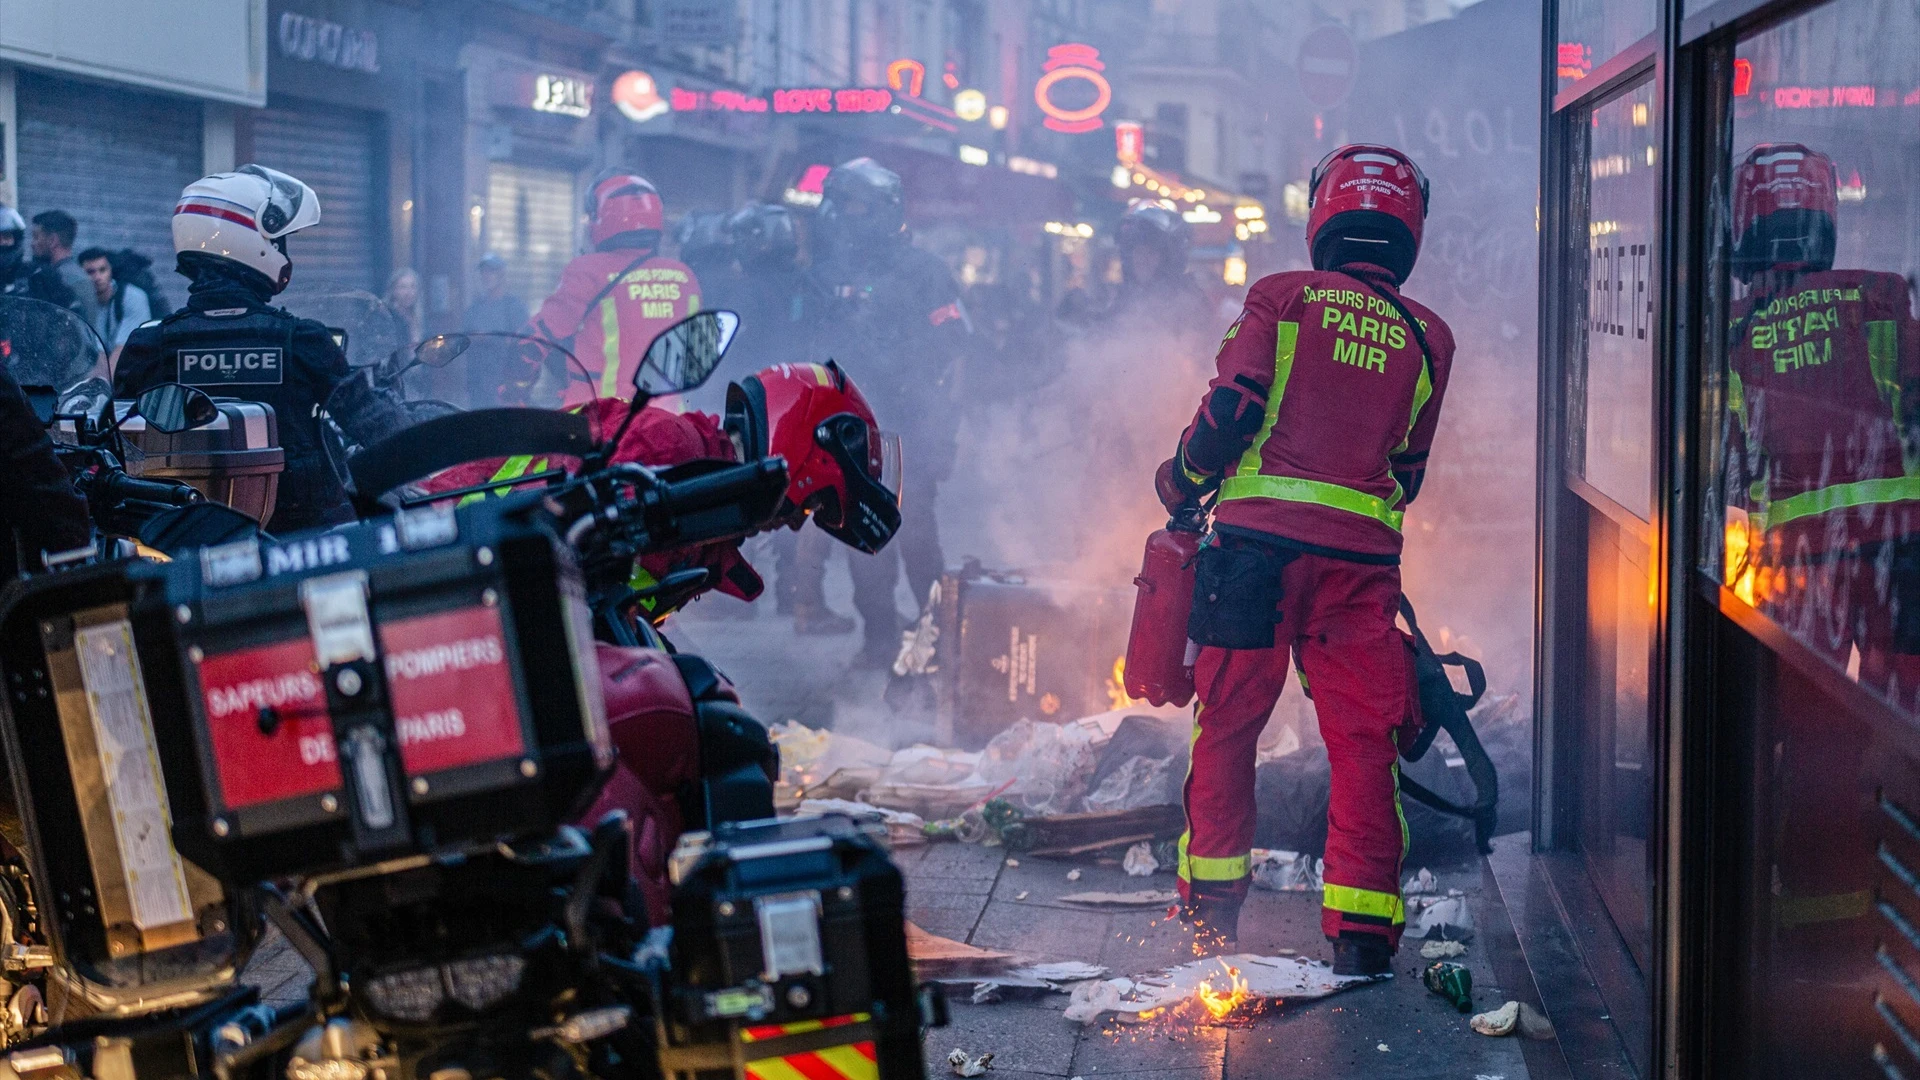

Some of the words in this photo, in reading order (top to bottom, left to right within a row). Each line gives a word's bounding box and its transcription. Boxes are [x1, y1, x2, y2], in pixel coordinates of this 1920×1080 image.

[774, 88, 832, 113] LOVE
[1340, 177, 1405, 197] SAPEURS-POMPIERS
[1356, 184, 1368, 192] DE
[1370, 185, 1391, 196] PARIS
[628, 283, 681, 301] PARIS
[1302, 285, 1365, 310] SAPEURS
[1630, 244, 1653, 343] TEA
[641, 301, 674, 319] MIR
[1322, 306, 1407, 350] PARIS
[183, 352, 277, 371] POLICE
[1332, 337, 1388, 374] MIR
[267, 534, 352, 577] MIR
[386, 635, 504, 681] POMPIERS
[300, 734, 337, 766] DE
[399, 707, 466, 746] PARIS
